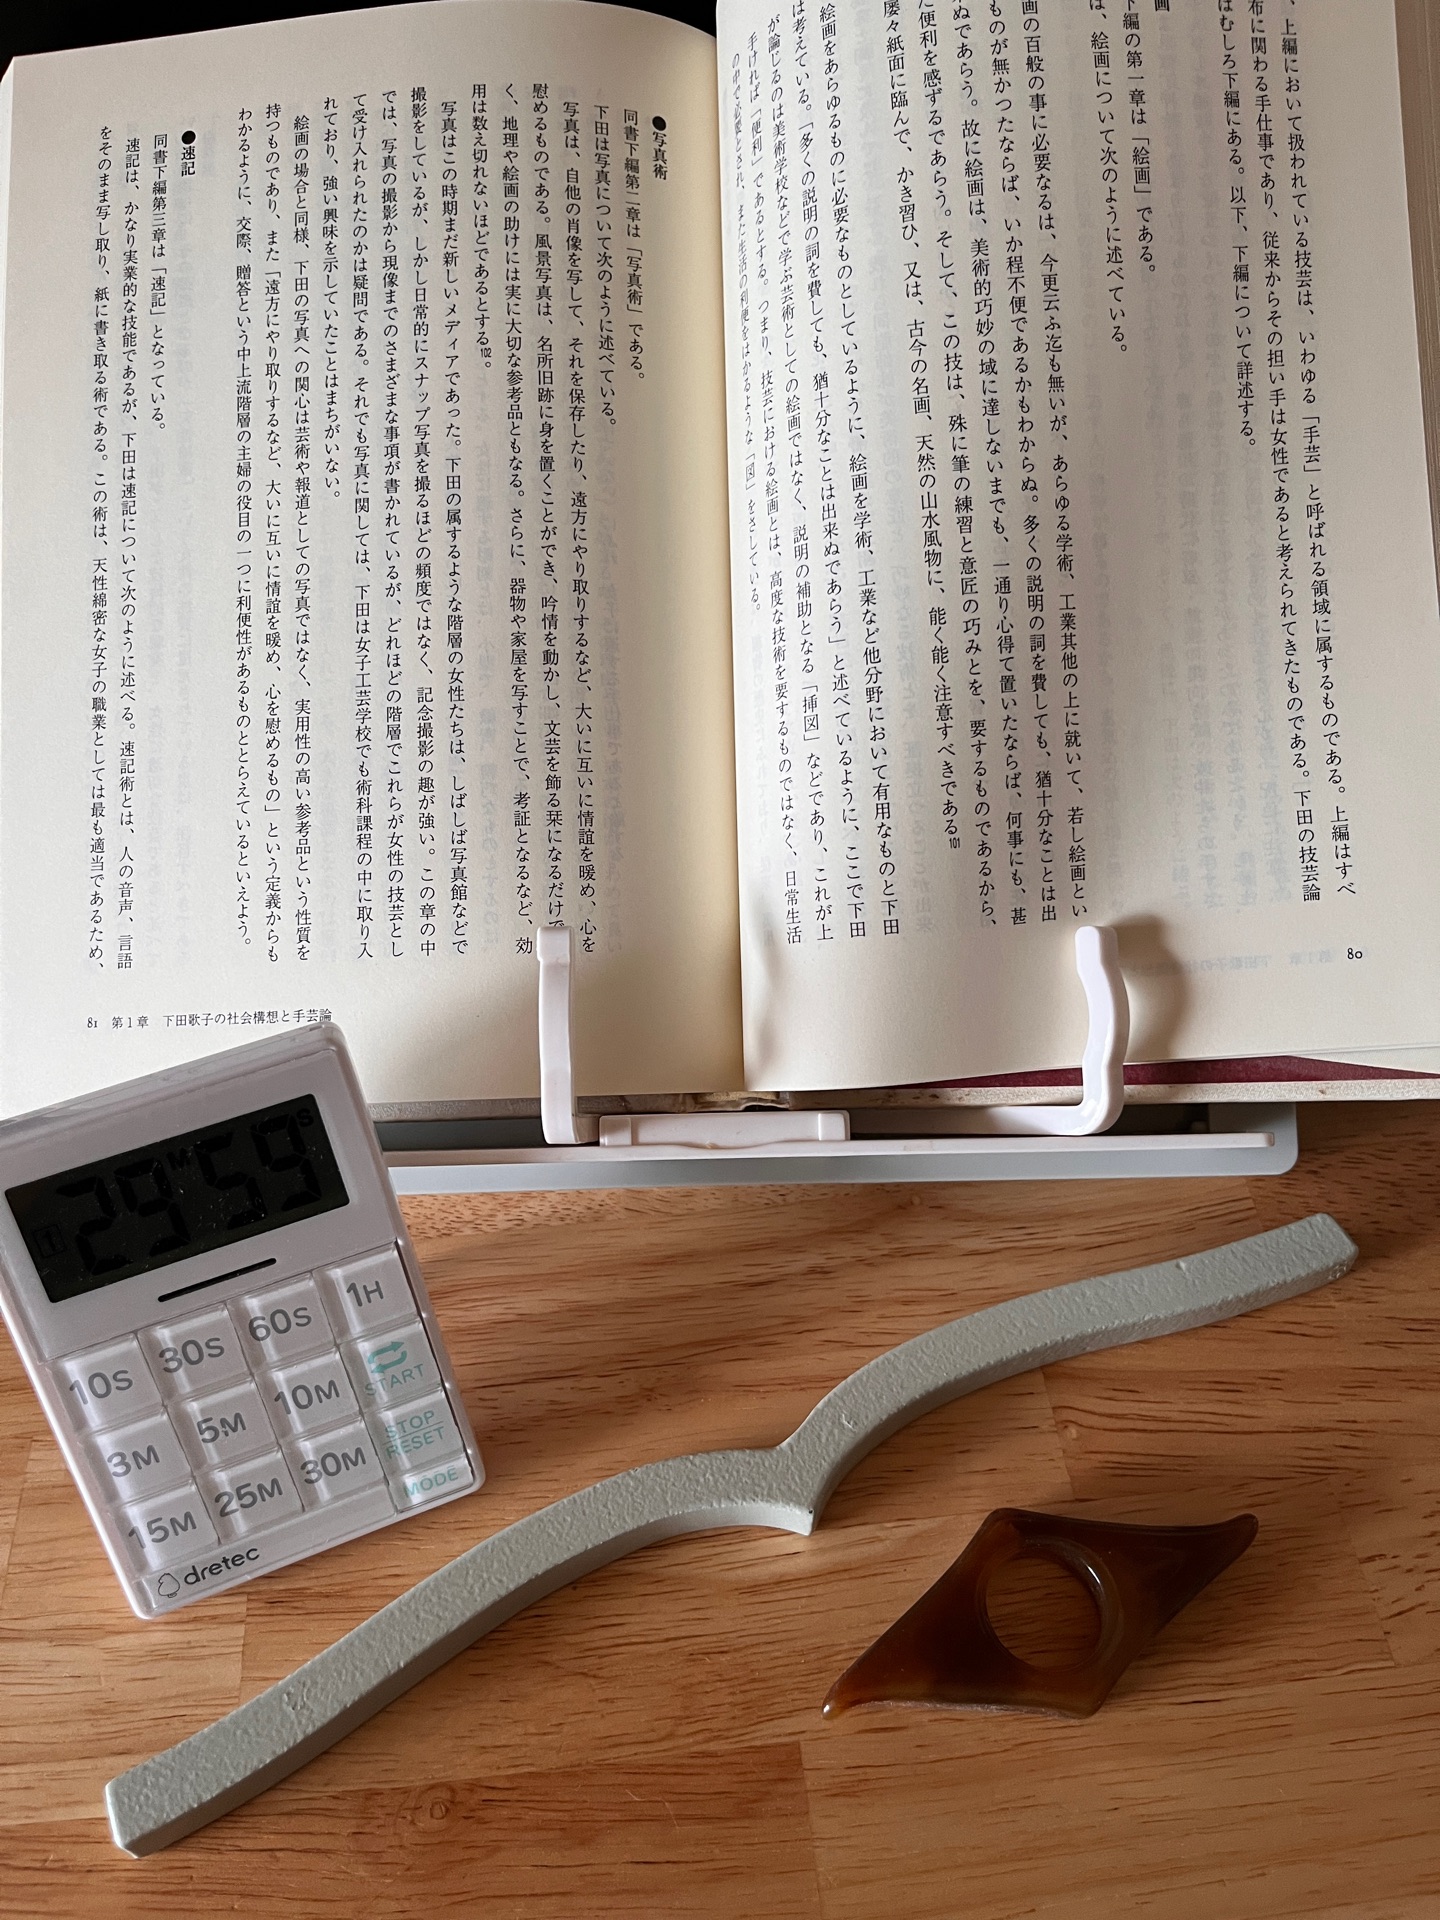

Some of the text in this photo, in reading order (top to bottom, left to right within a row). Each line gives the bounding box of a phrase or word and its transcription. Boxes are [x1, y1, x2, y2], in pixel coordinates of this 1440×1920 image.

[623, 108, 645, 379] 同書下編第二章は「写真術」である。
[149, 133, 169, 430] 同書下編第三章は「速記」となっている。
[593, 104, 617, 425] 下田は写真について次のように述べている。
[952, 0, 1027, 926] ぬであらう。故に絵画は、美術的巧妙の域に達しないまでも、一通り心得て置いたならば、何事にも、甚
[1346, 946, 1364, 960] 80
[87, 1017, 98, 1029] 81
[163, 1008, 332, 1027] 下田歌子の社会構想と手芸論
[346, 1280, 384, 1307] 1H
[248, 1307, 312, 1342] 60S
[159, 1337, 225, 1373] 30S
[69, 1369, 134, 1405] 10S
[274, 1379, 341, 1415] 10M
[364, 1363, 424, 1397] START
[197, 1412, 247, 1444] 5M
[384, 1410, 435, 1439] STOP
[385, 1426, 445, 1459] RESET
[107, 1444, 160, 1478] 3M
[300, 1446, 367, 1485] 30M
[214, 1477, 283, 1518] 25M
[403, 1464, 459, 1498] MODE
[128, 1511, 197, 1550] 15M
[183, 1547, 260, 1586] dretec
